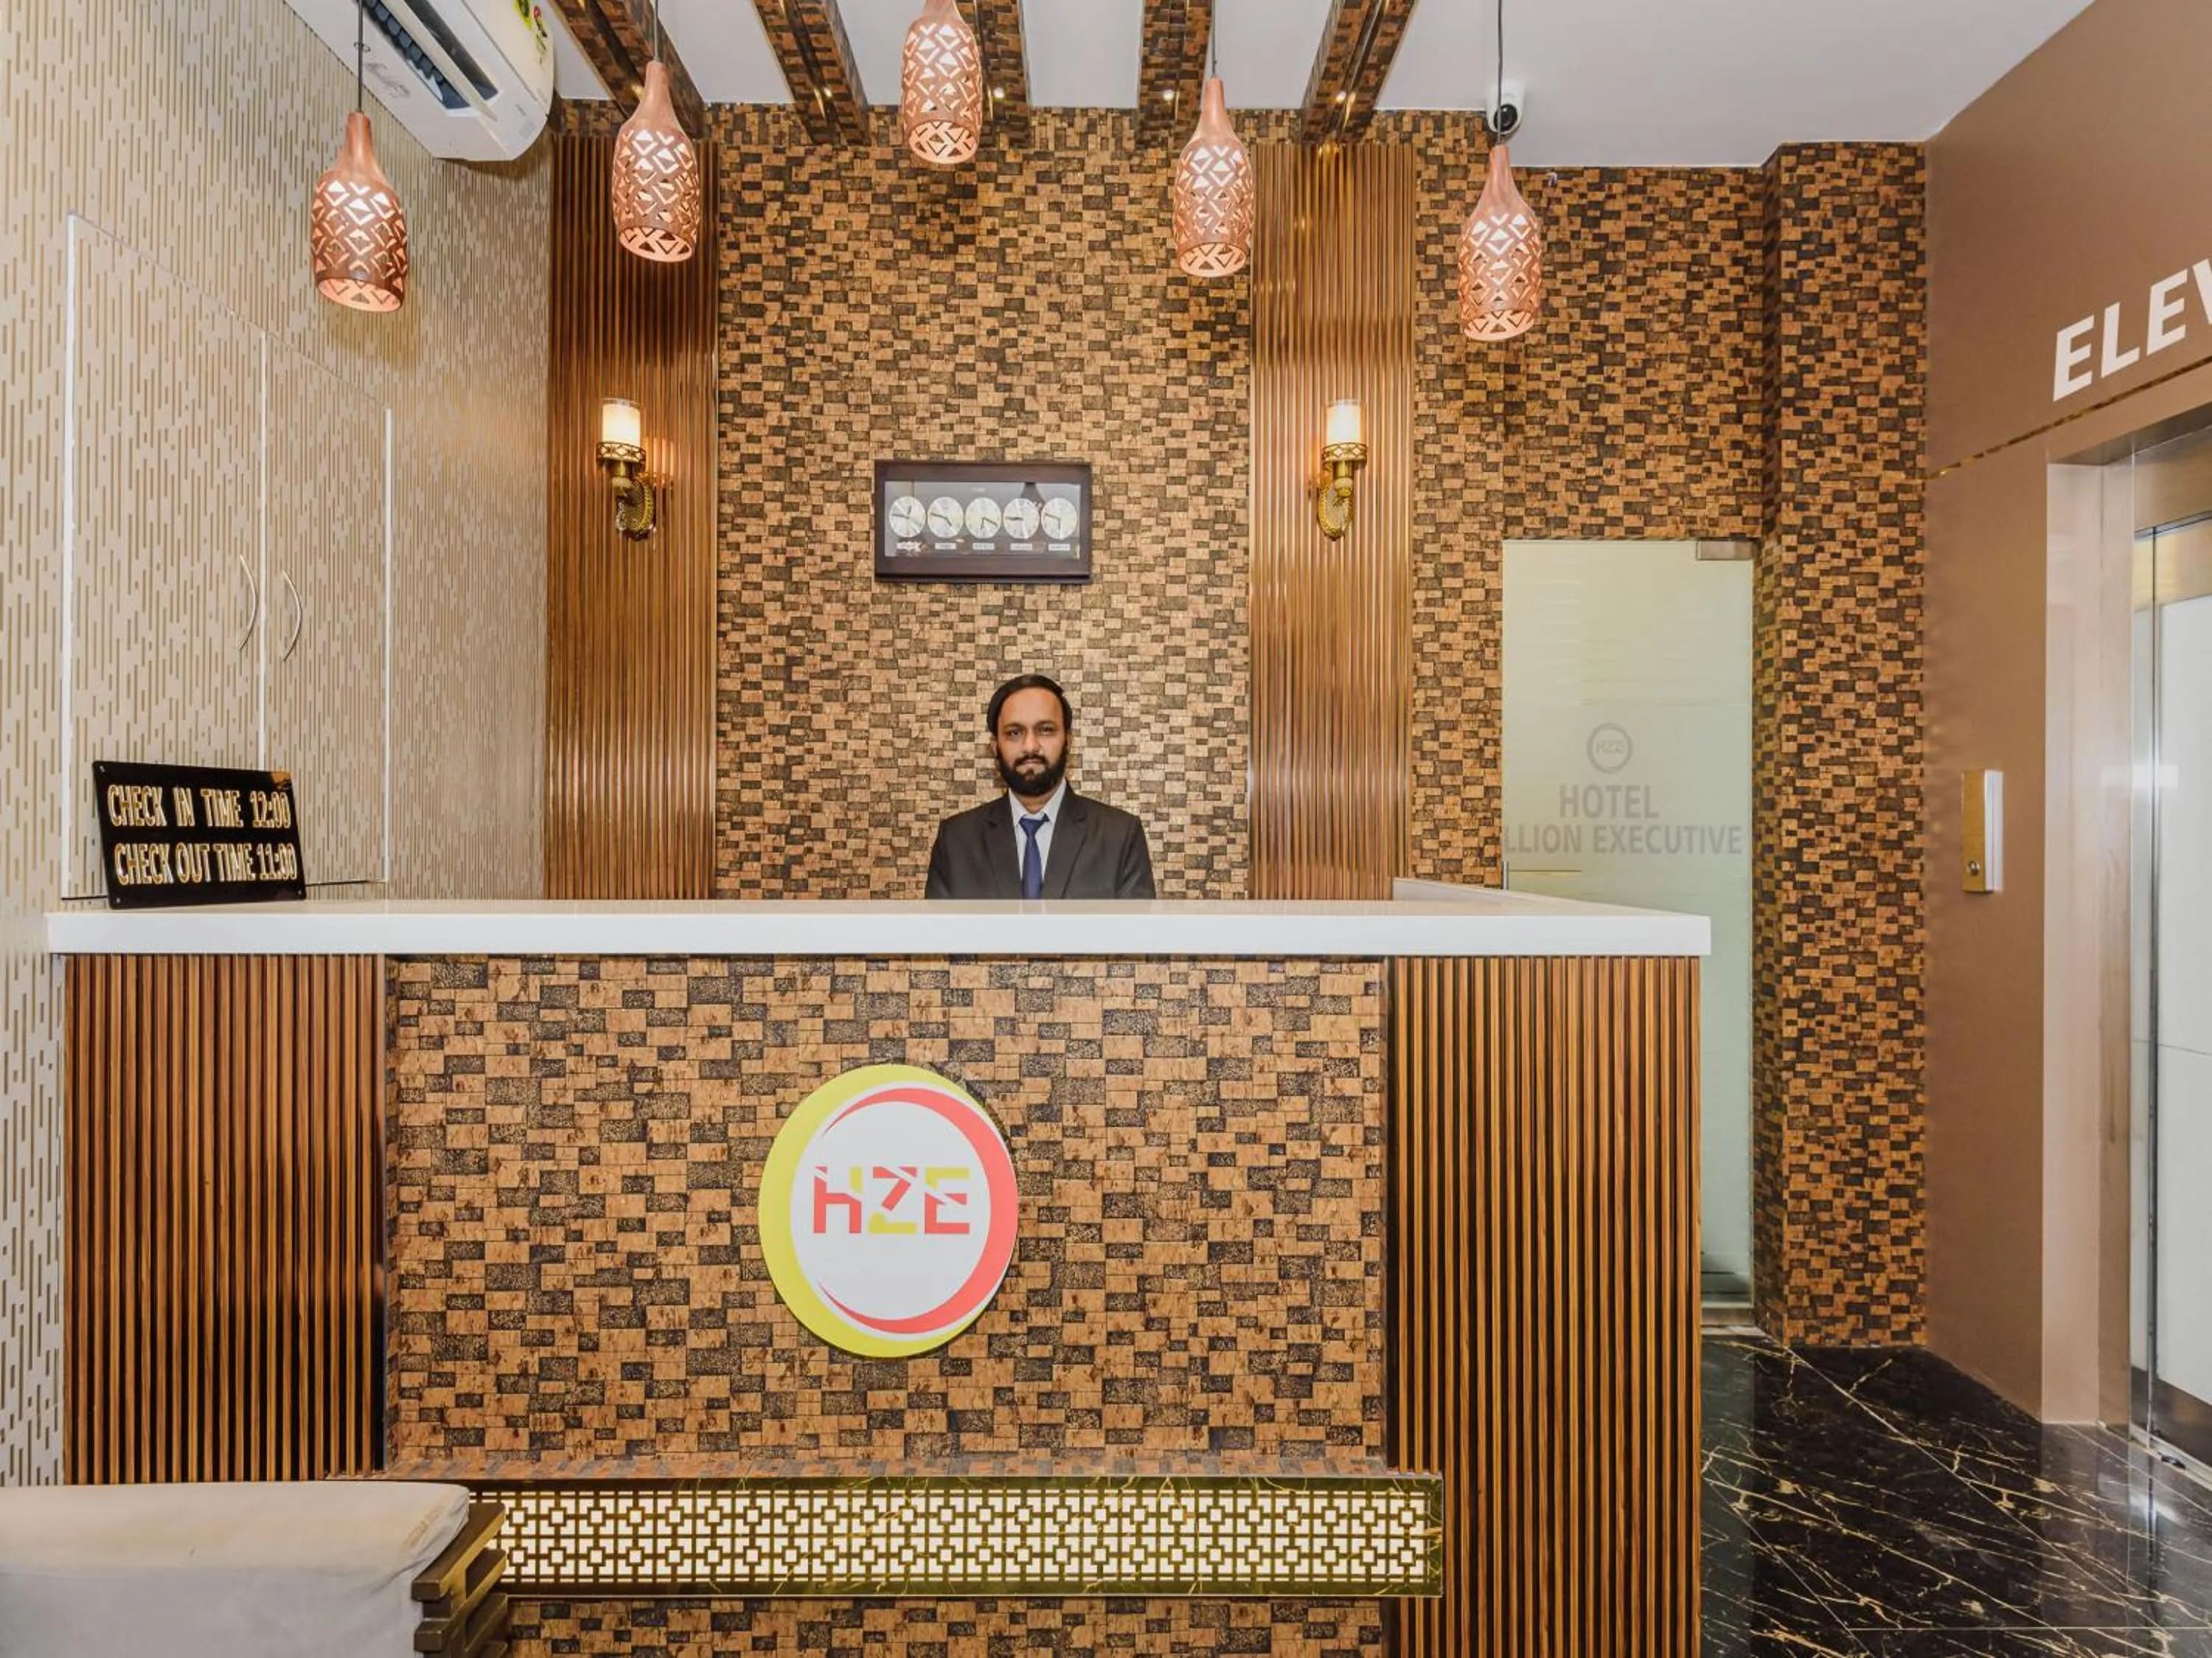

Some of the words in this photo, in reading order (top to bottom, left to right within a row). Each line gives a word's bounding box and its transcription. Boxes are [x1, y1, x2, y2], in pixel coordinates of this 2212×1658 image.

[108, 785, 167, 827] CHECK
[173, 786, 195, 827] IN
[200, 788, 243, 828] TIME
[250, 791, 291, 828] 12:00
[1559, 784, 1660, 819] HOTEL
[1593, 825, 1742, 855] EXECUTIVE
[114, 842, 174, 885] CHECK
[175, 842, 212, 883] OUT
[212, 843, 256, 882] TIME
[257, 842, 297, 881] 11:00
[813, 1166, 970, 1235] HZE
